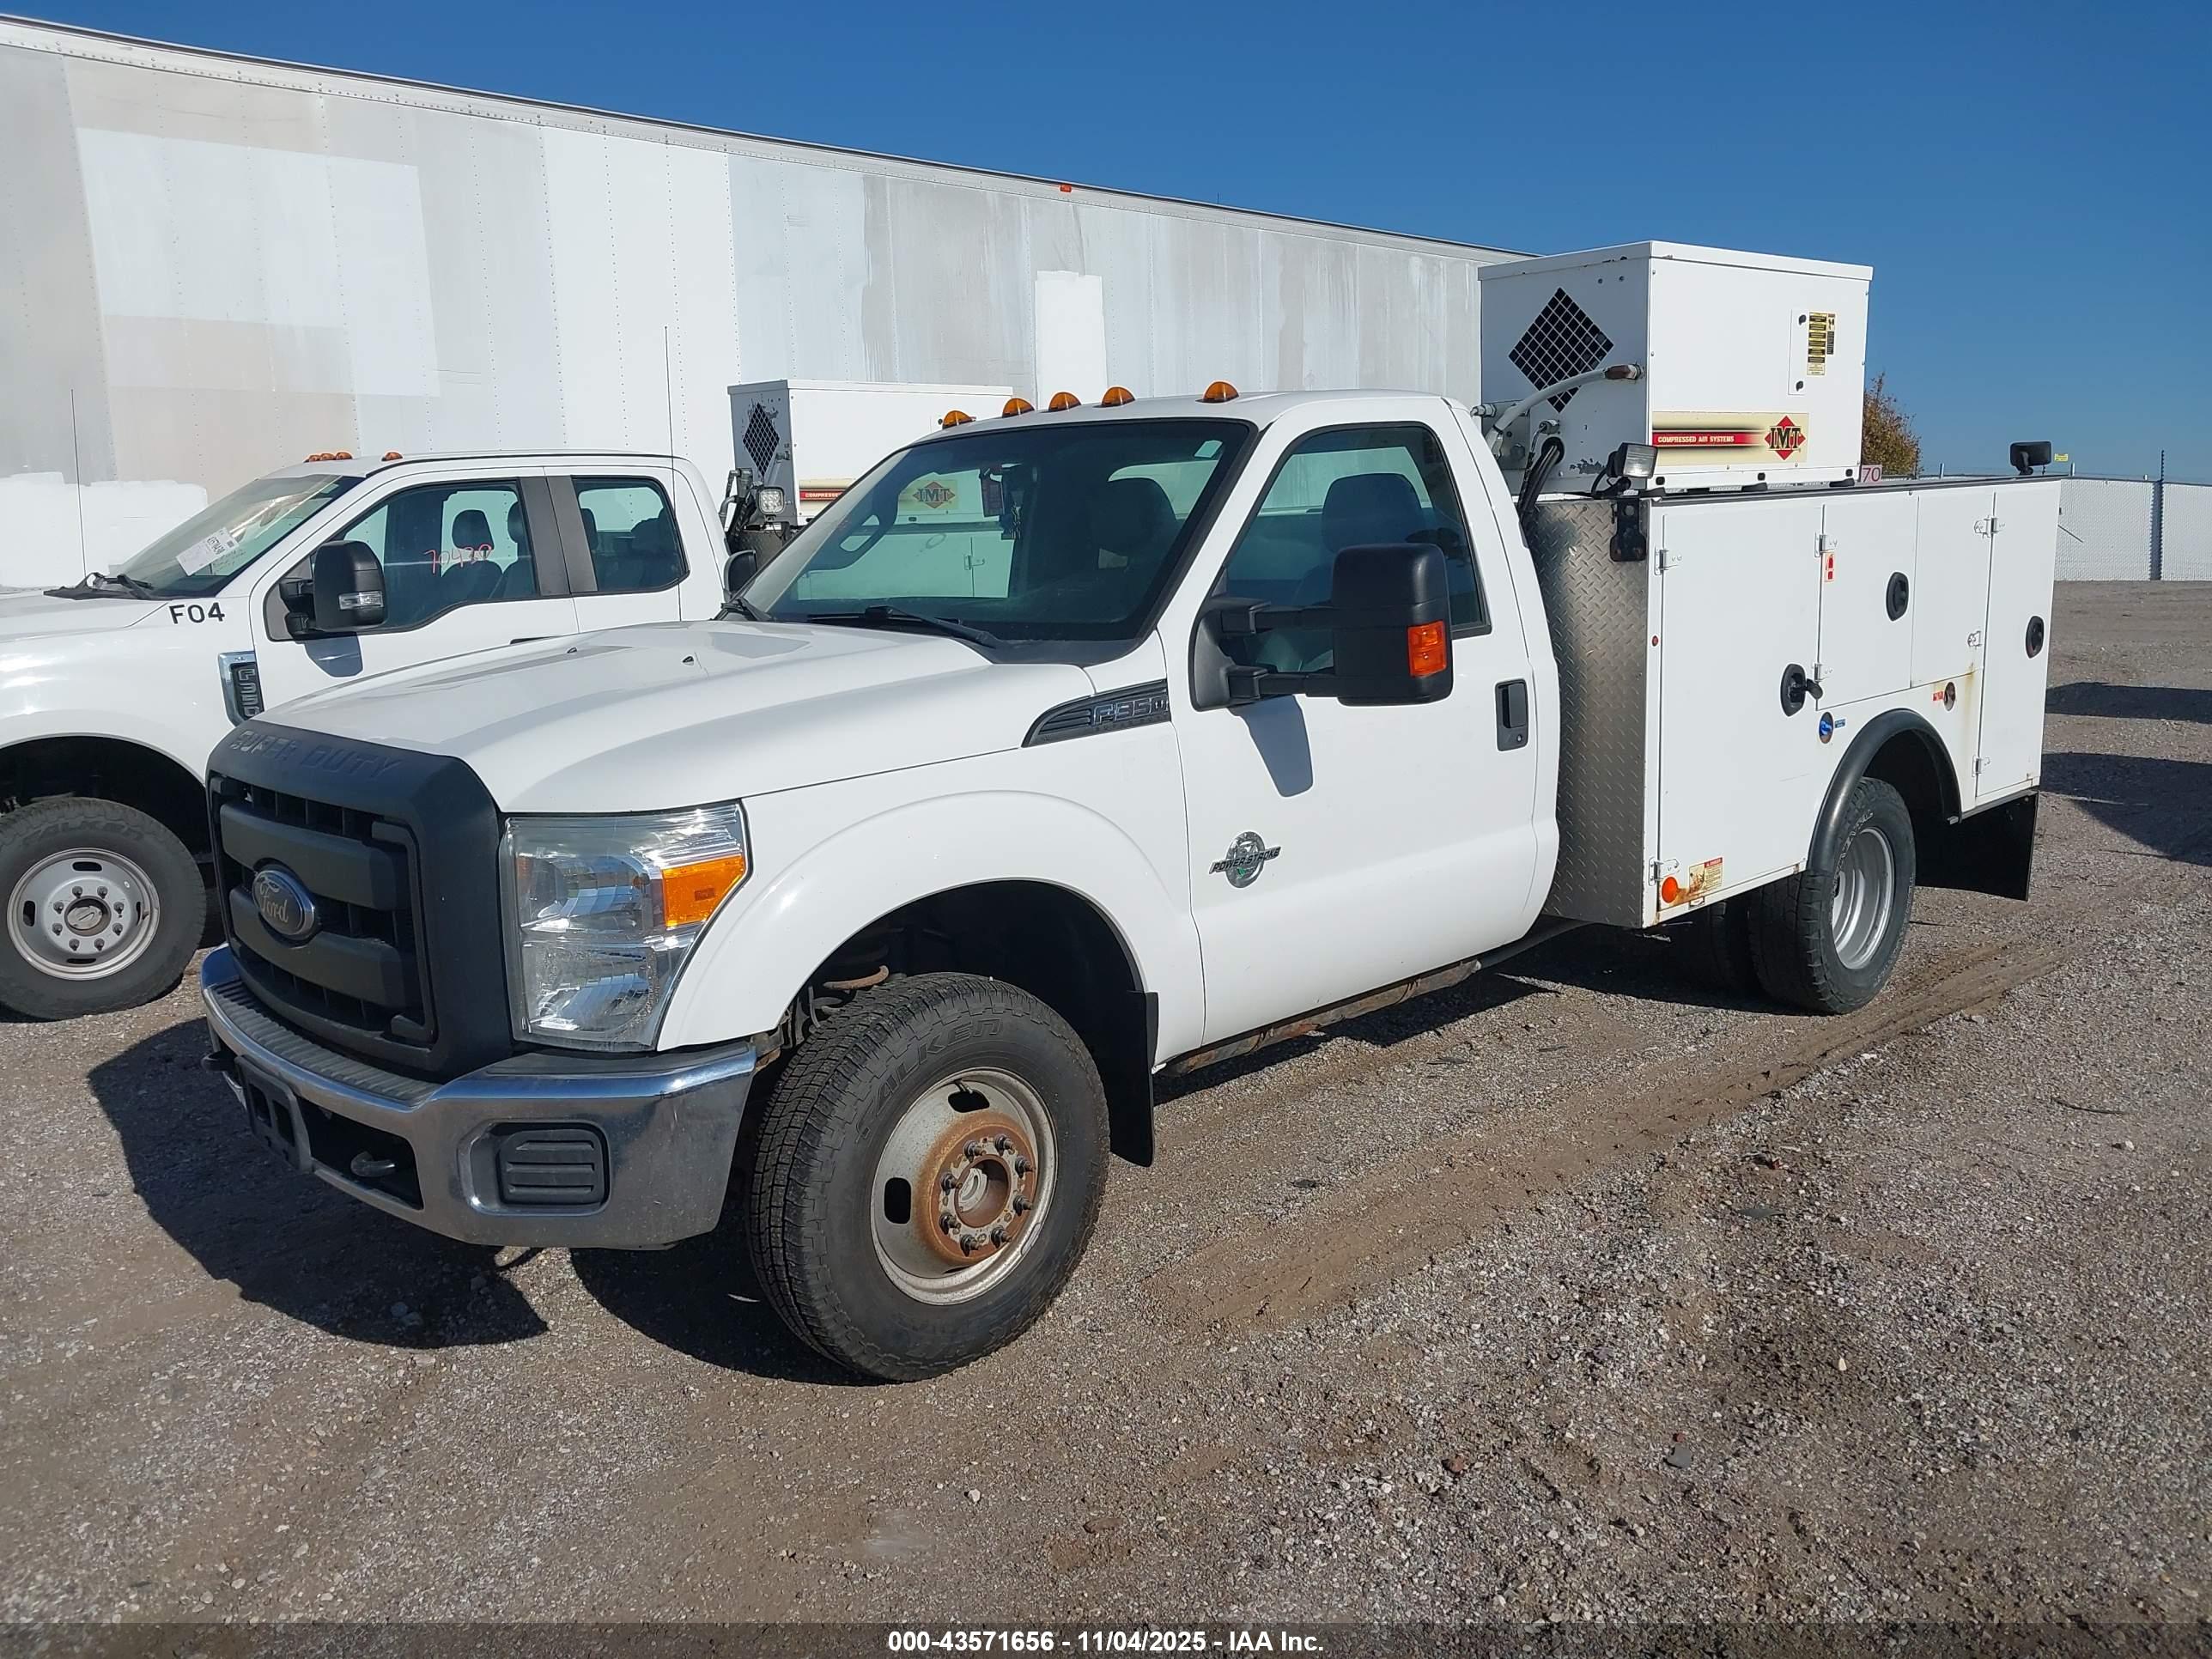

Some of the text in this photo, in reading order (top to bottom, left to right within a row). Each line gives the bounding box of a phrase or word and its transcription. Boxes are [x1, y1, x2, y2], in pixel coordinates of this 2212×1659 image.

[1769, 427, 1802, 449] IMT
[918, 488, 951, 502] IMT
[168, 602, 226, 625] F04
[300, 744, 403, 781] DUTY
[1210, 857, 1246, 873] POWER
[260, 874, 289, 923] Ford
